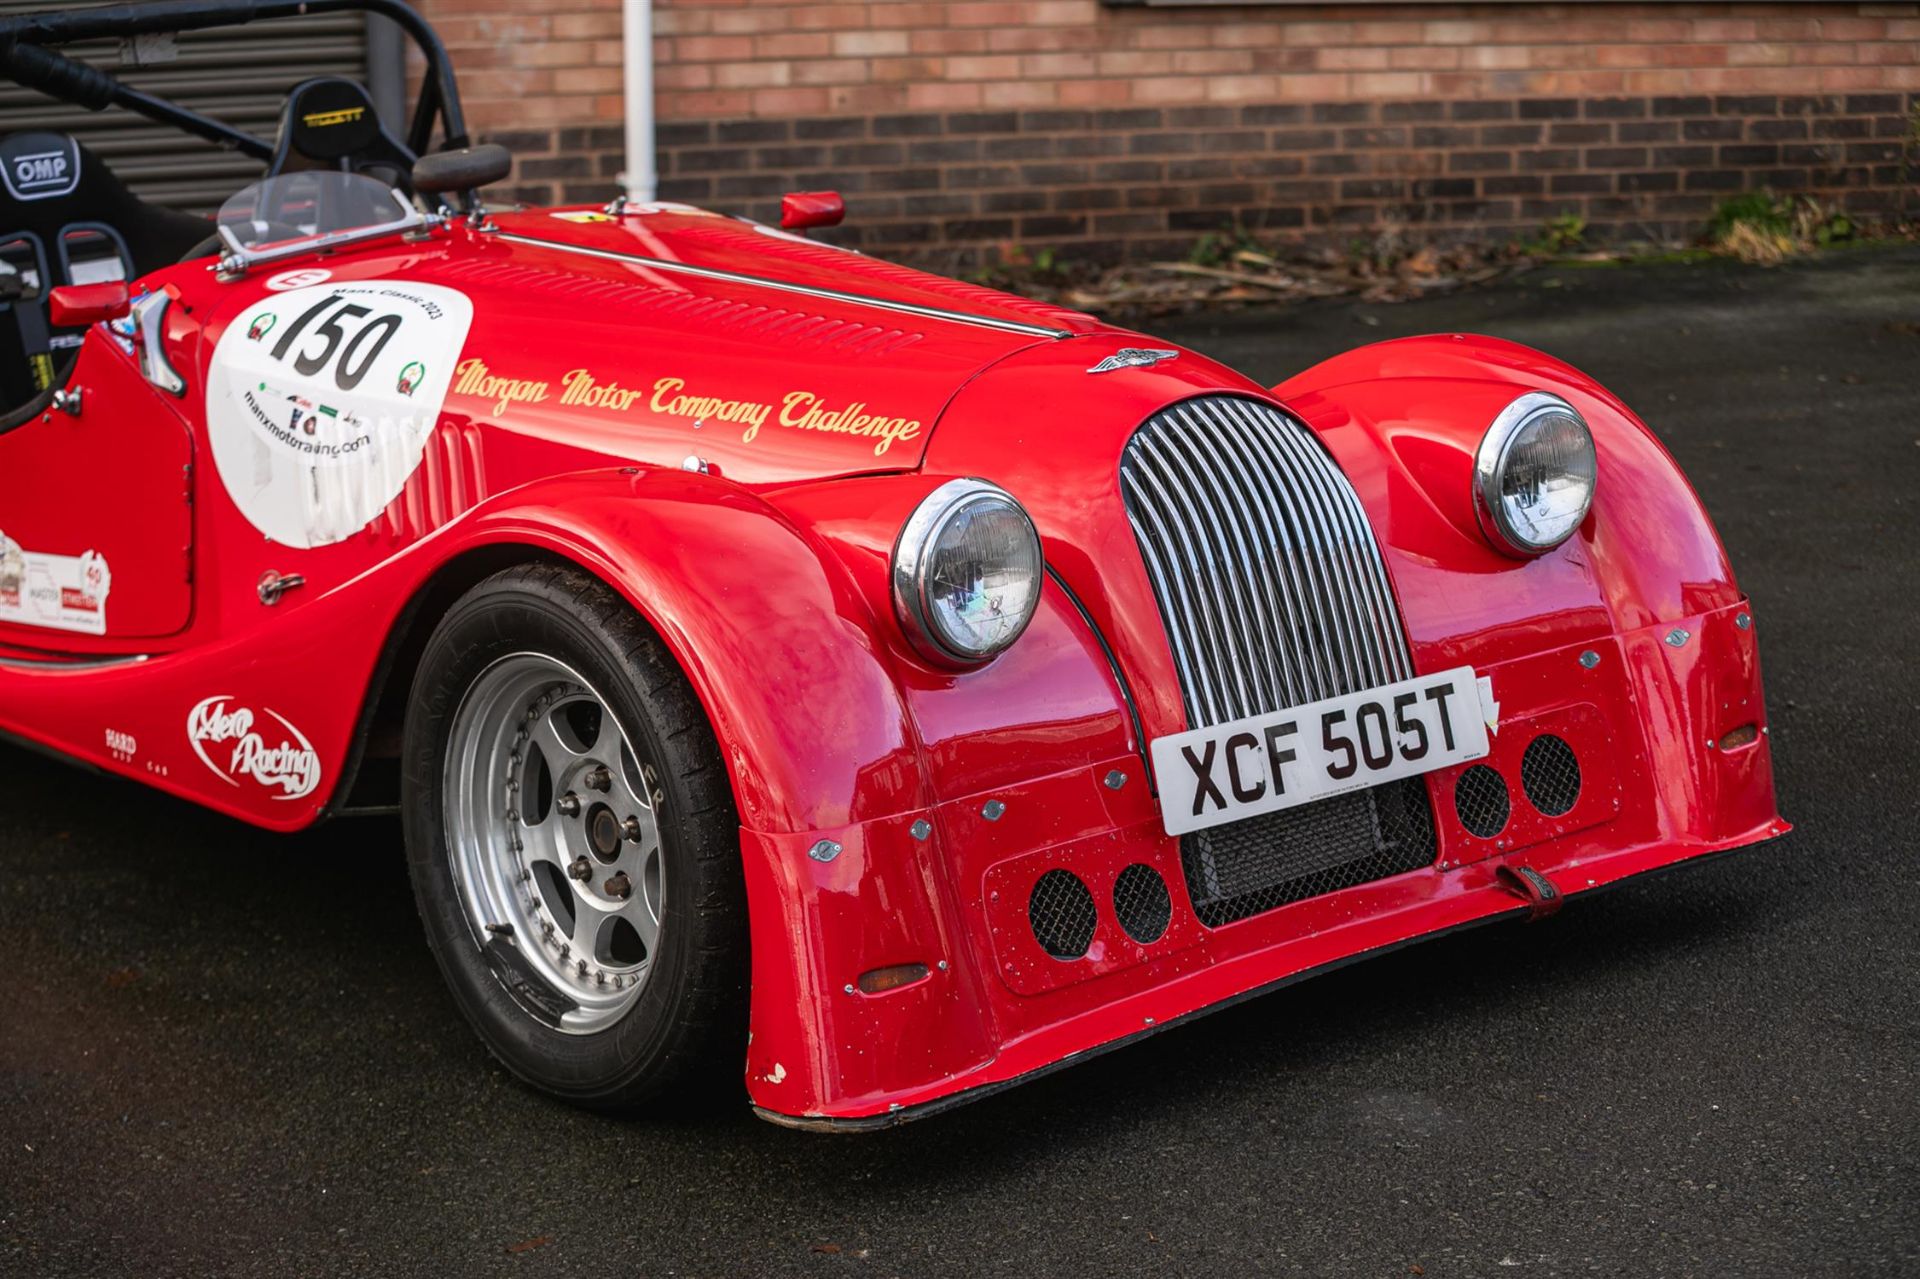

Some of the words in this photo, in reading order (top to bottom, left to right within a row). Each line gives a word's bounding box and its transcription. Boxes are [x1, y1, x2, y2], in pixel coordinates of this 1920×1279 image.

[17, 157, 67, 182] OMP
[277, 271, 324, 286] E
[331, 287, 374, 295] Manx
[380, 289, 423, 303] Classic
[421, 301, 443, 320] 2023
[270, 294, 402, 391] 150
[454, 358, 549, 417] Morgan
[560, 368, 641, 411] Motor
[650, 378, 772, 443] Company
[778, 391, 921, 456] Challenge
[195, 702, 254, 743] Aero
[231, 732, 314, 794] Racing
[1181, 720, 1299, 817] XCF
[1321, 682, 1455, 780] 505T
